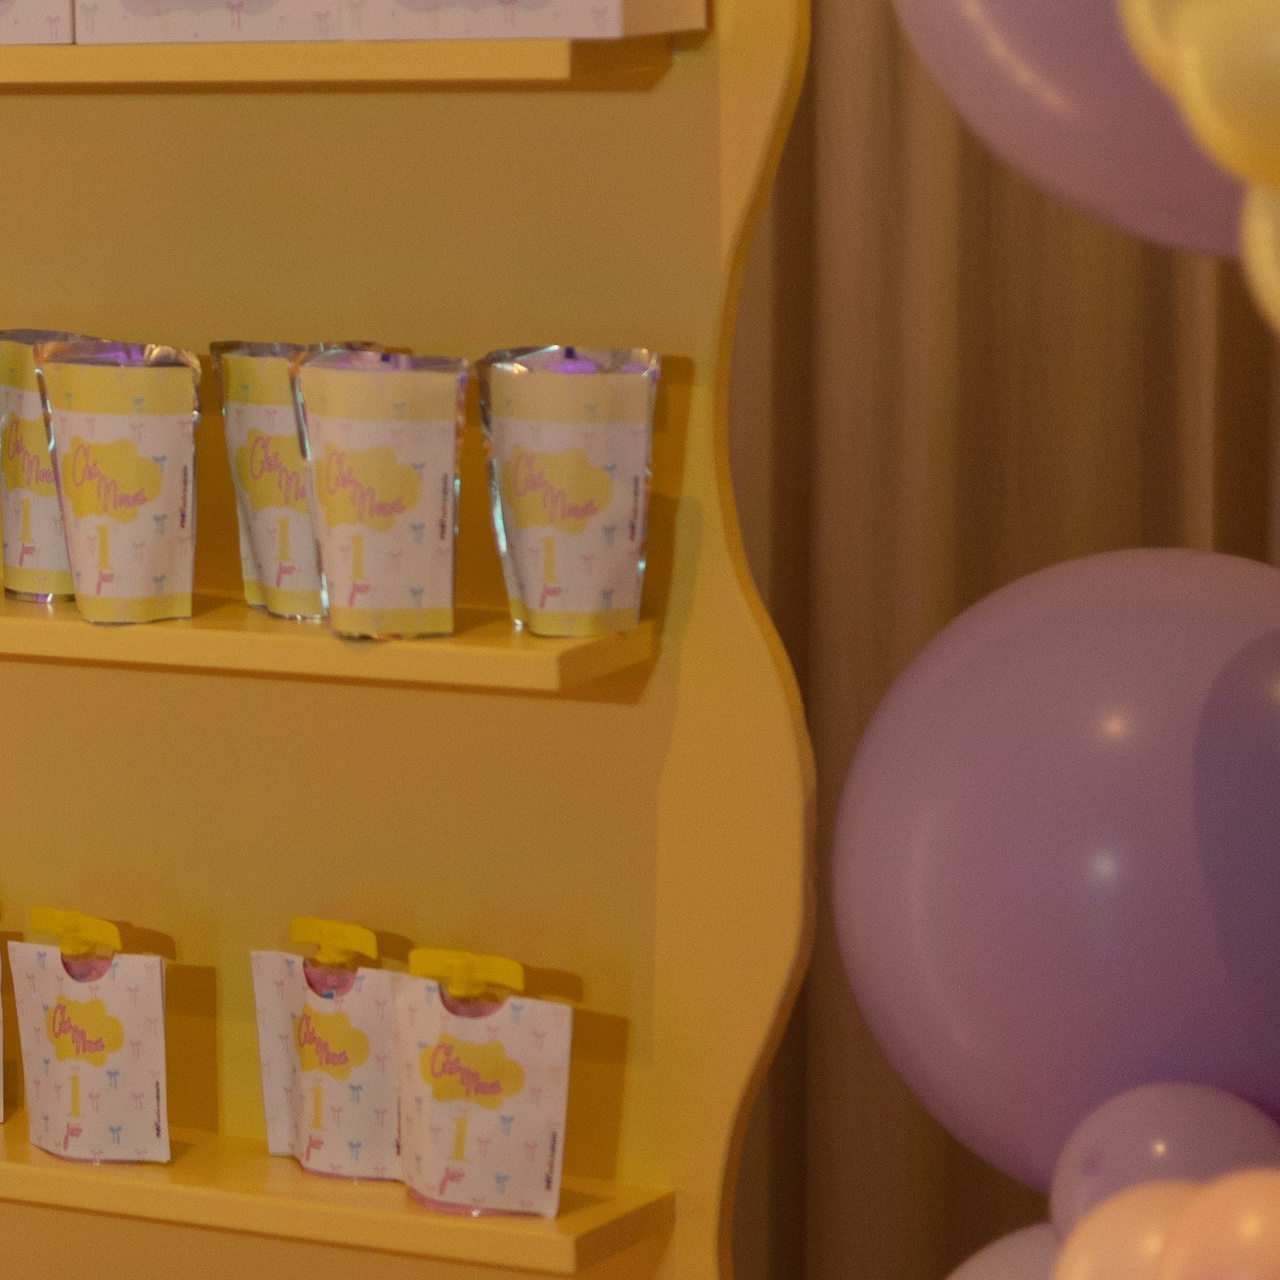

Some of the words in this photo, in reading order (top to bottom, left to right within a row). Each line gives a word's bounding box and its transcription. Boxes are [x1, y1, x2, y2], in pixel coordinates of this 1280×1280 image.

[70, 1075, 82, 1116] 1
[310, 1086, 323, 1129] 1
[450, 1117, 469, 1161] 1
